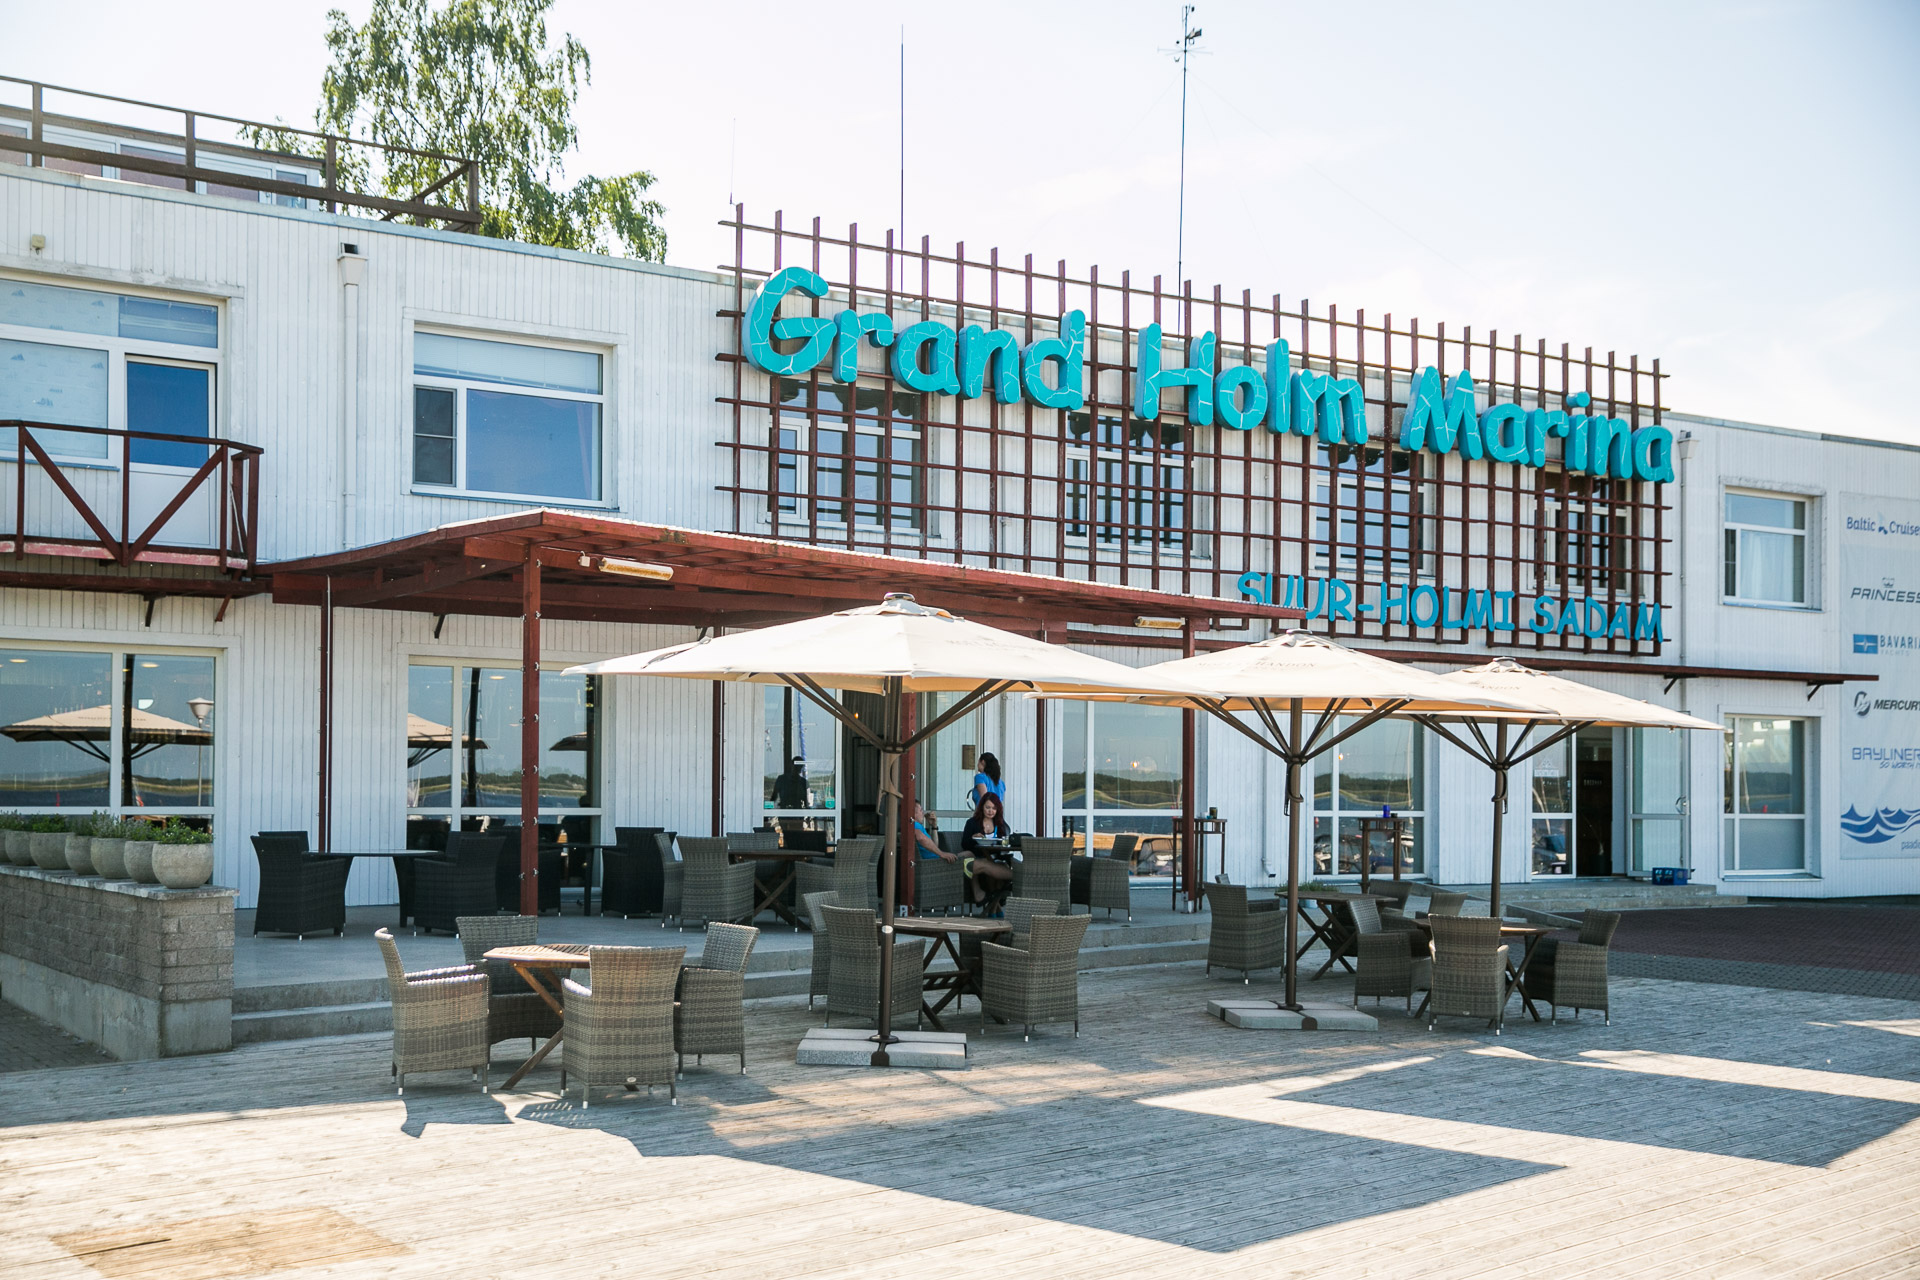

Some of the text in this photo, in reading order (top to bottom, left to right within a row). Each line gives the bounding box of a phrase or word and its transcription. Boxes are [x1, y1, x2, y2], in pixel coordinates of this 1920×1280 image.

[742, 266, 1675, 484] Grand Holm Marina
[1847, 516, 1876, 531] Baltic
[1529, 595, 1664, 643] SADAM
